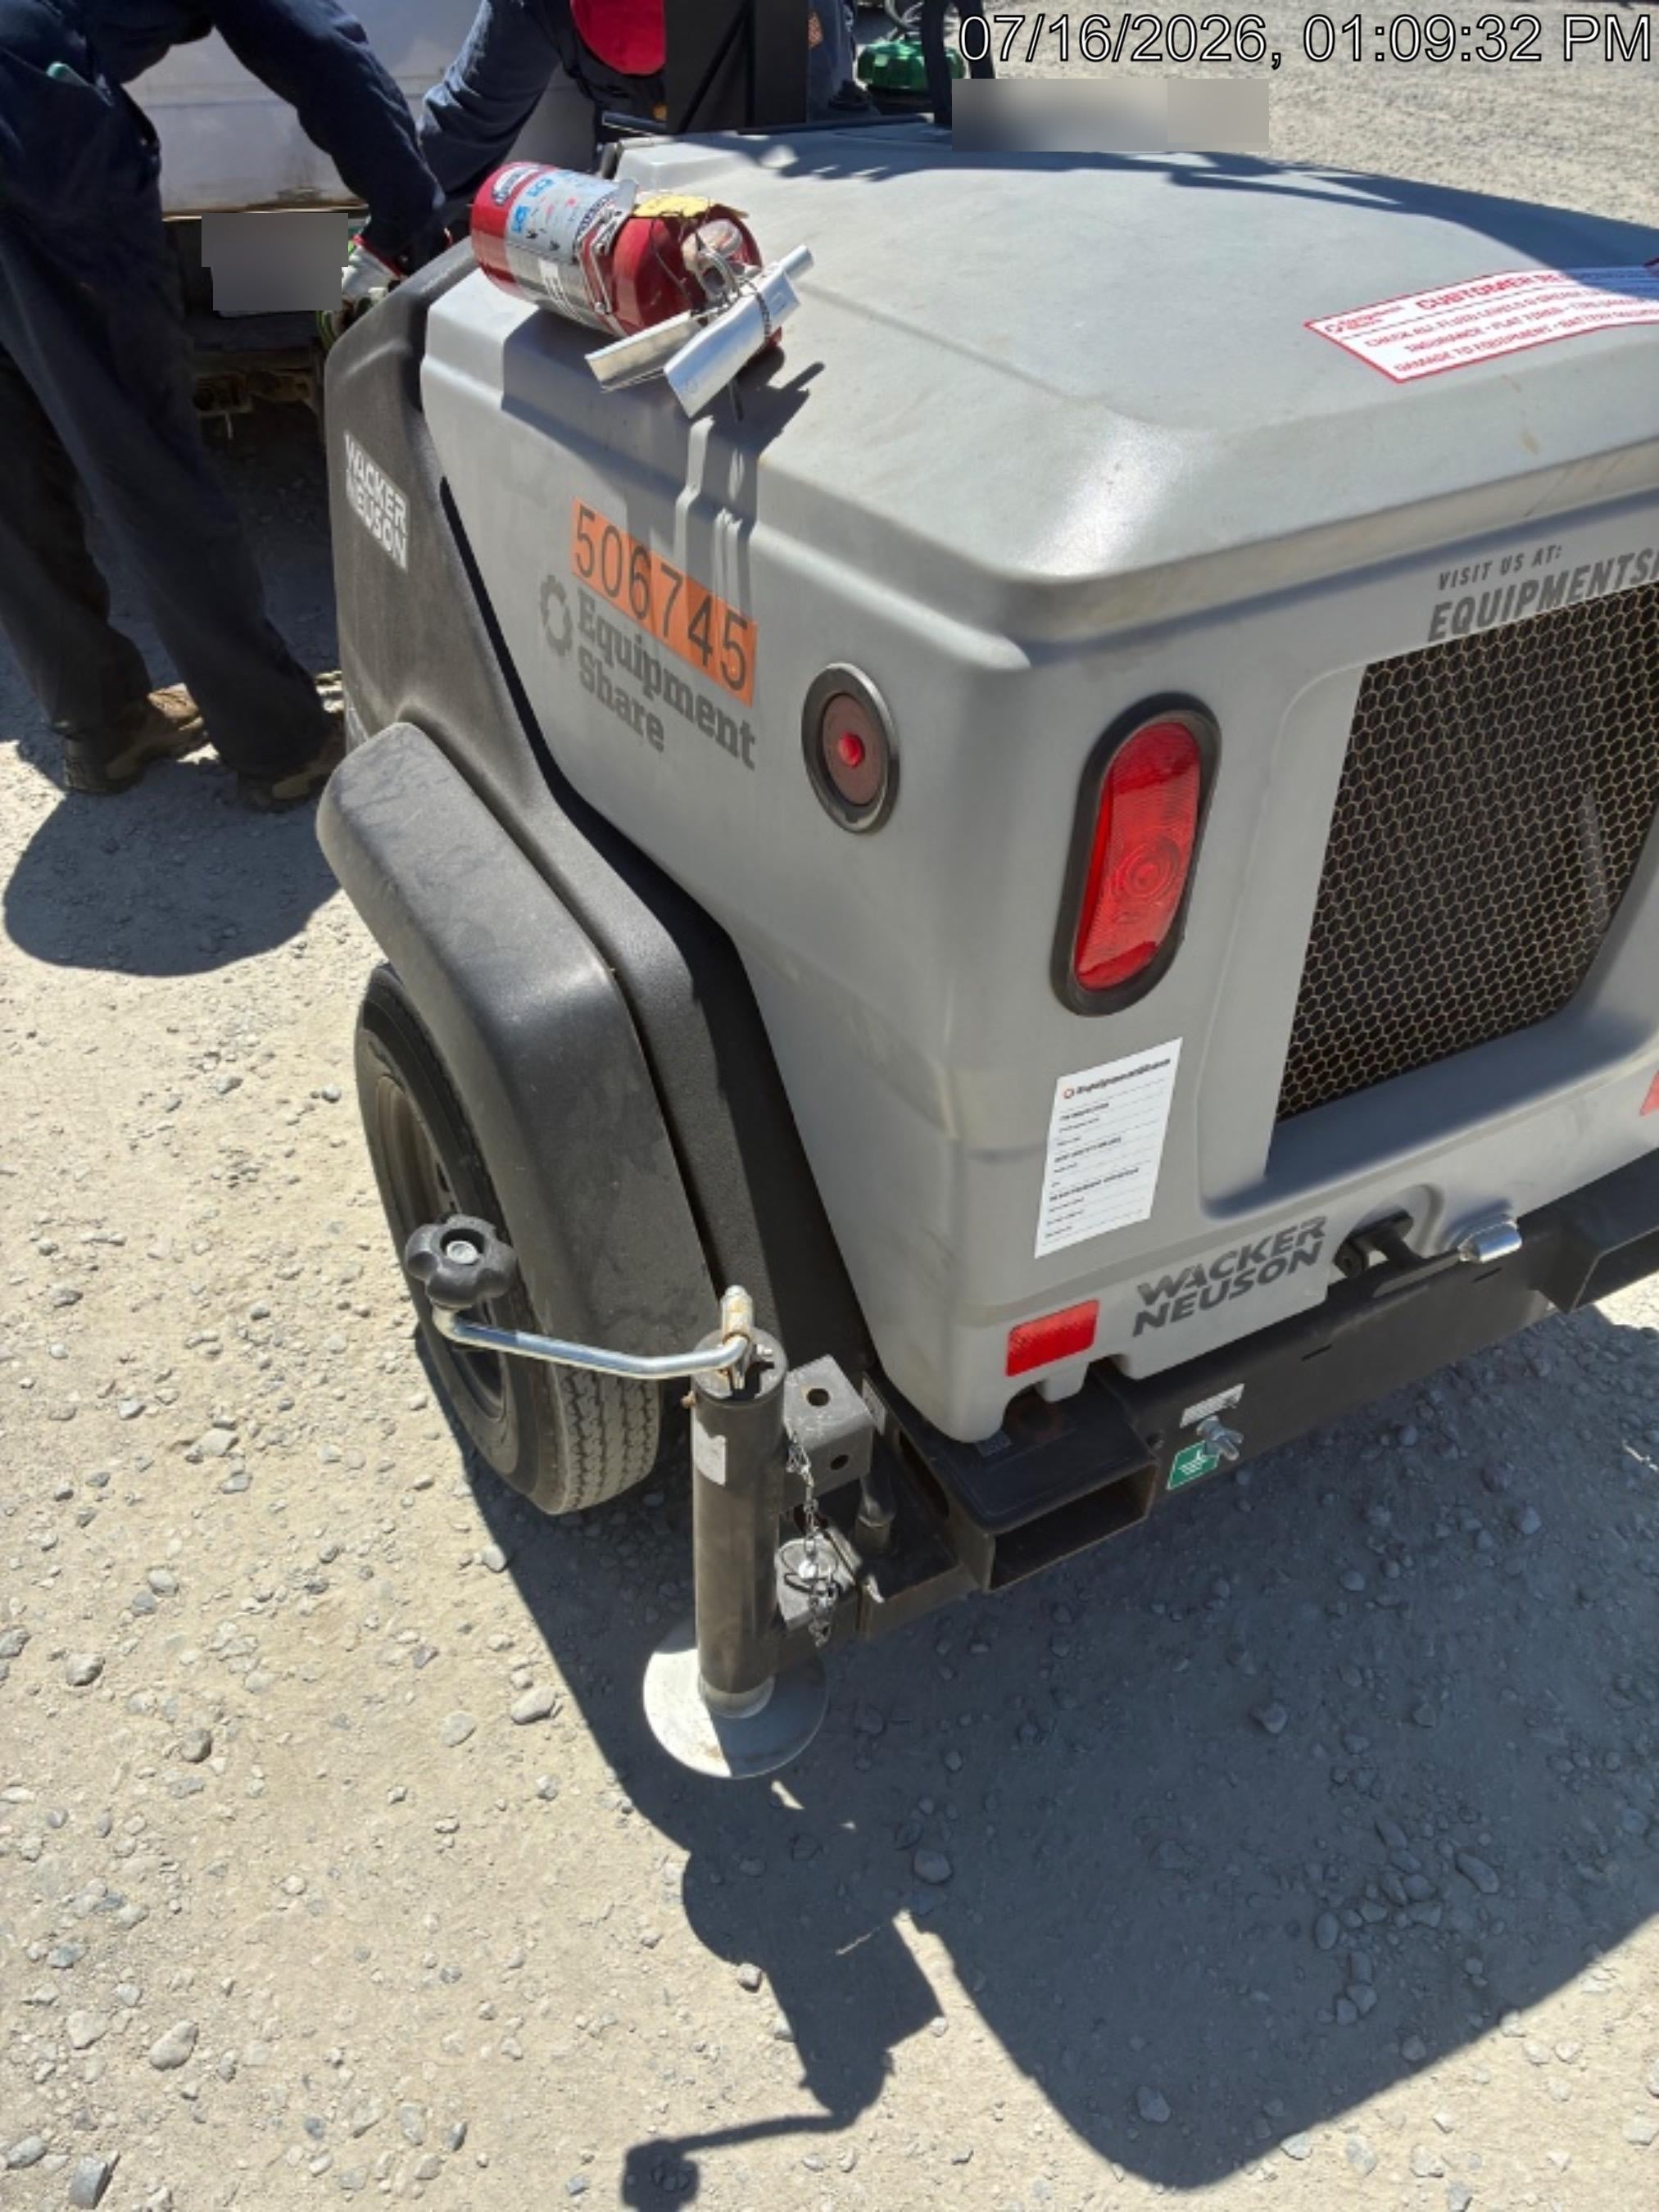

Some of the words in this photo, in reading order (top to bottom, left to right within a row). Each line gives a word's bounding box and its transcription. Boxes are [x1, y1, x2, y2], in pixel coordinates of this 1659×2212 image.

[1416, 275, 1532, 310] CUSTOMER
[344, 433, 407, 534] WACKER
[347, 469, 407, 570] NEUSON
[574, 505, 748, 692] 506745
[1439, 560, 1493, 592] VISIT
[1500, 552, 1525, 577] US
[1532, 544, 1563, 567] AT:
[578, 586, 756, 770] Equipment
[578, 649, 665, 753] Share
[1132, 1240, 1323, 1338] NEUSON
[1136, 1215, 1327, 1307] WACKER
